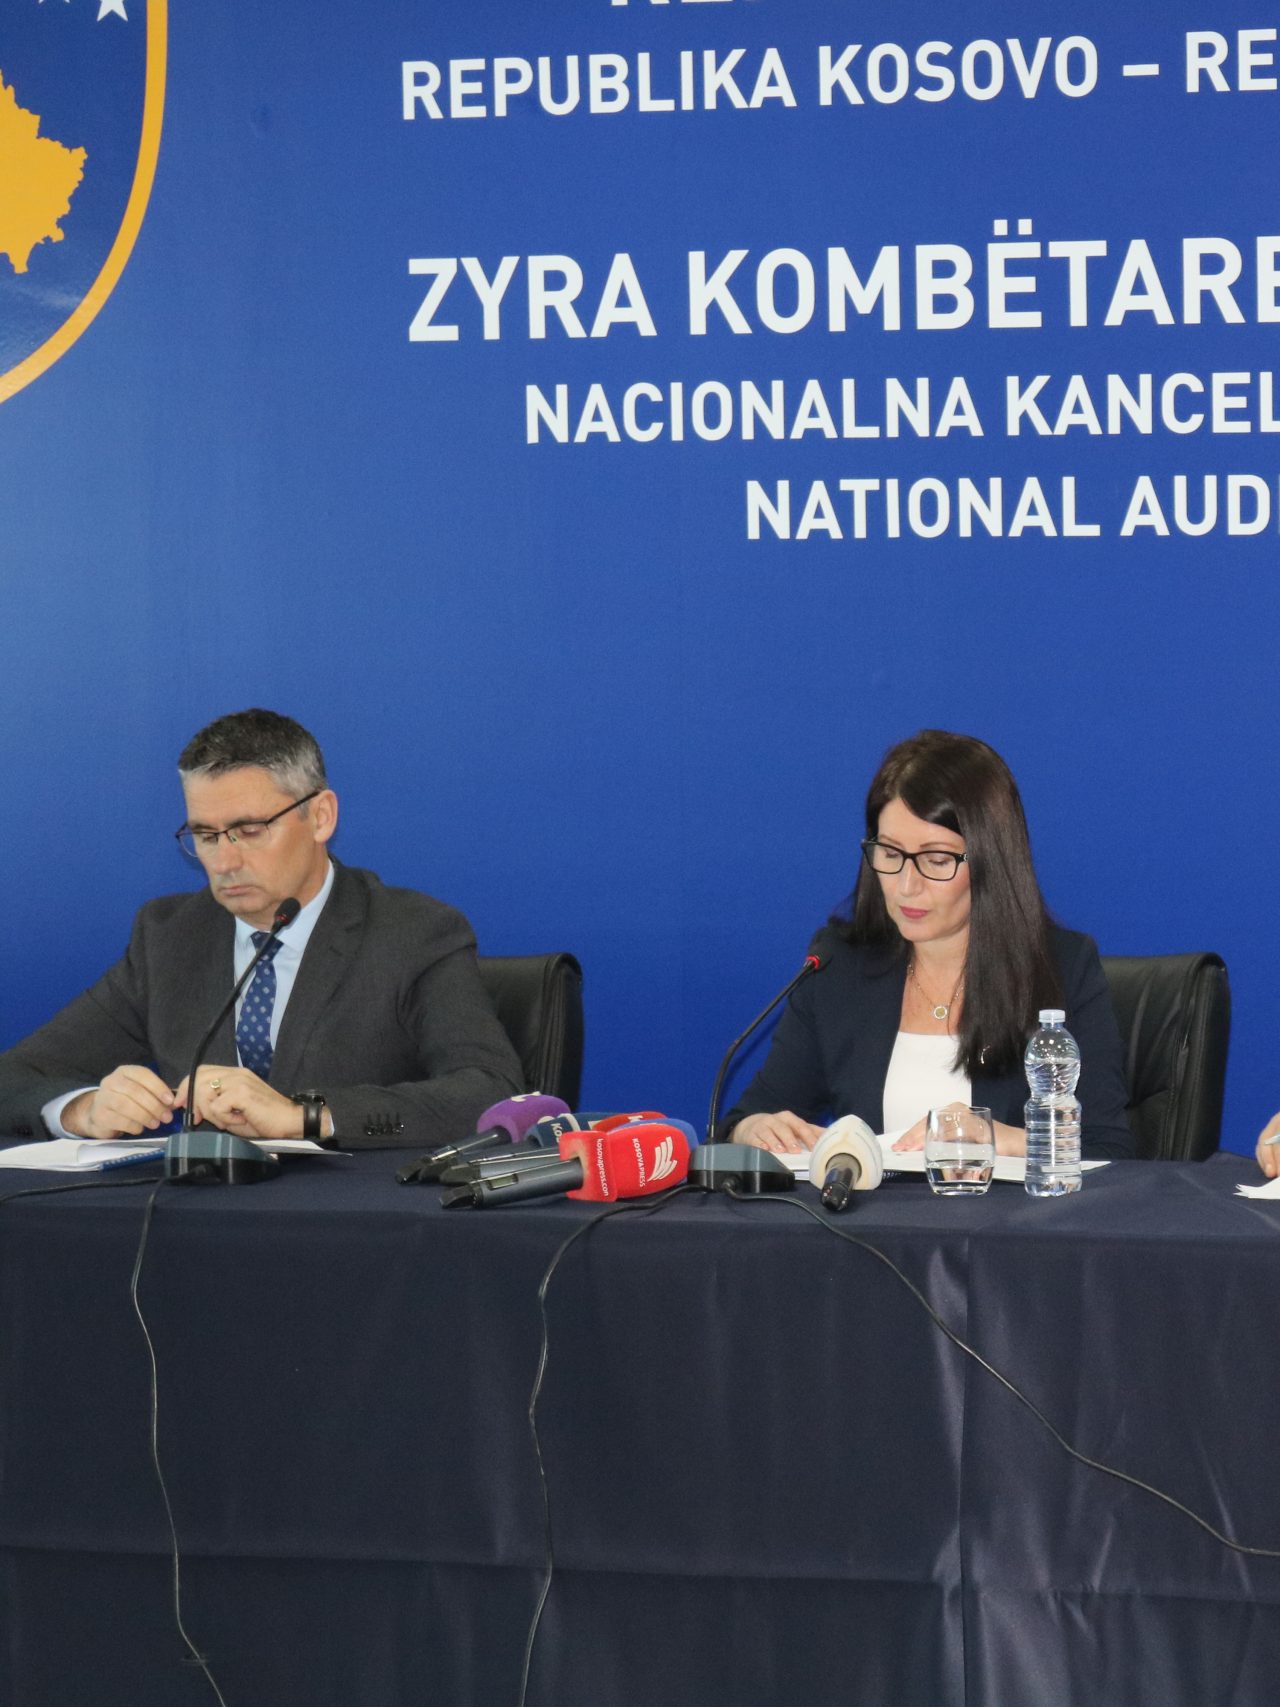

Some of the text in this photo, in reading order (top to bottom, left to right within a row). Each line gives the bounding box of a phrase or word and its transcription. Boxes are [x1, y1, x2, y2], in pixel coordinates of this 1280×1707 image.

[402, 48, 797, 120] REPUBLIKA
[818, 36, 1098, 106] KOSOVO
[408, 252, 657, 342] ZYRA
[526, 377, 984, 444] NACIONALNA
[746, 476, 1100, 540] NATIONAL
